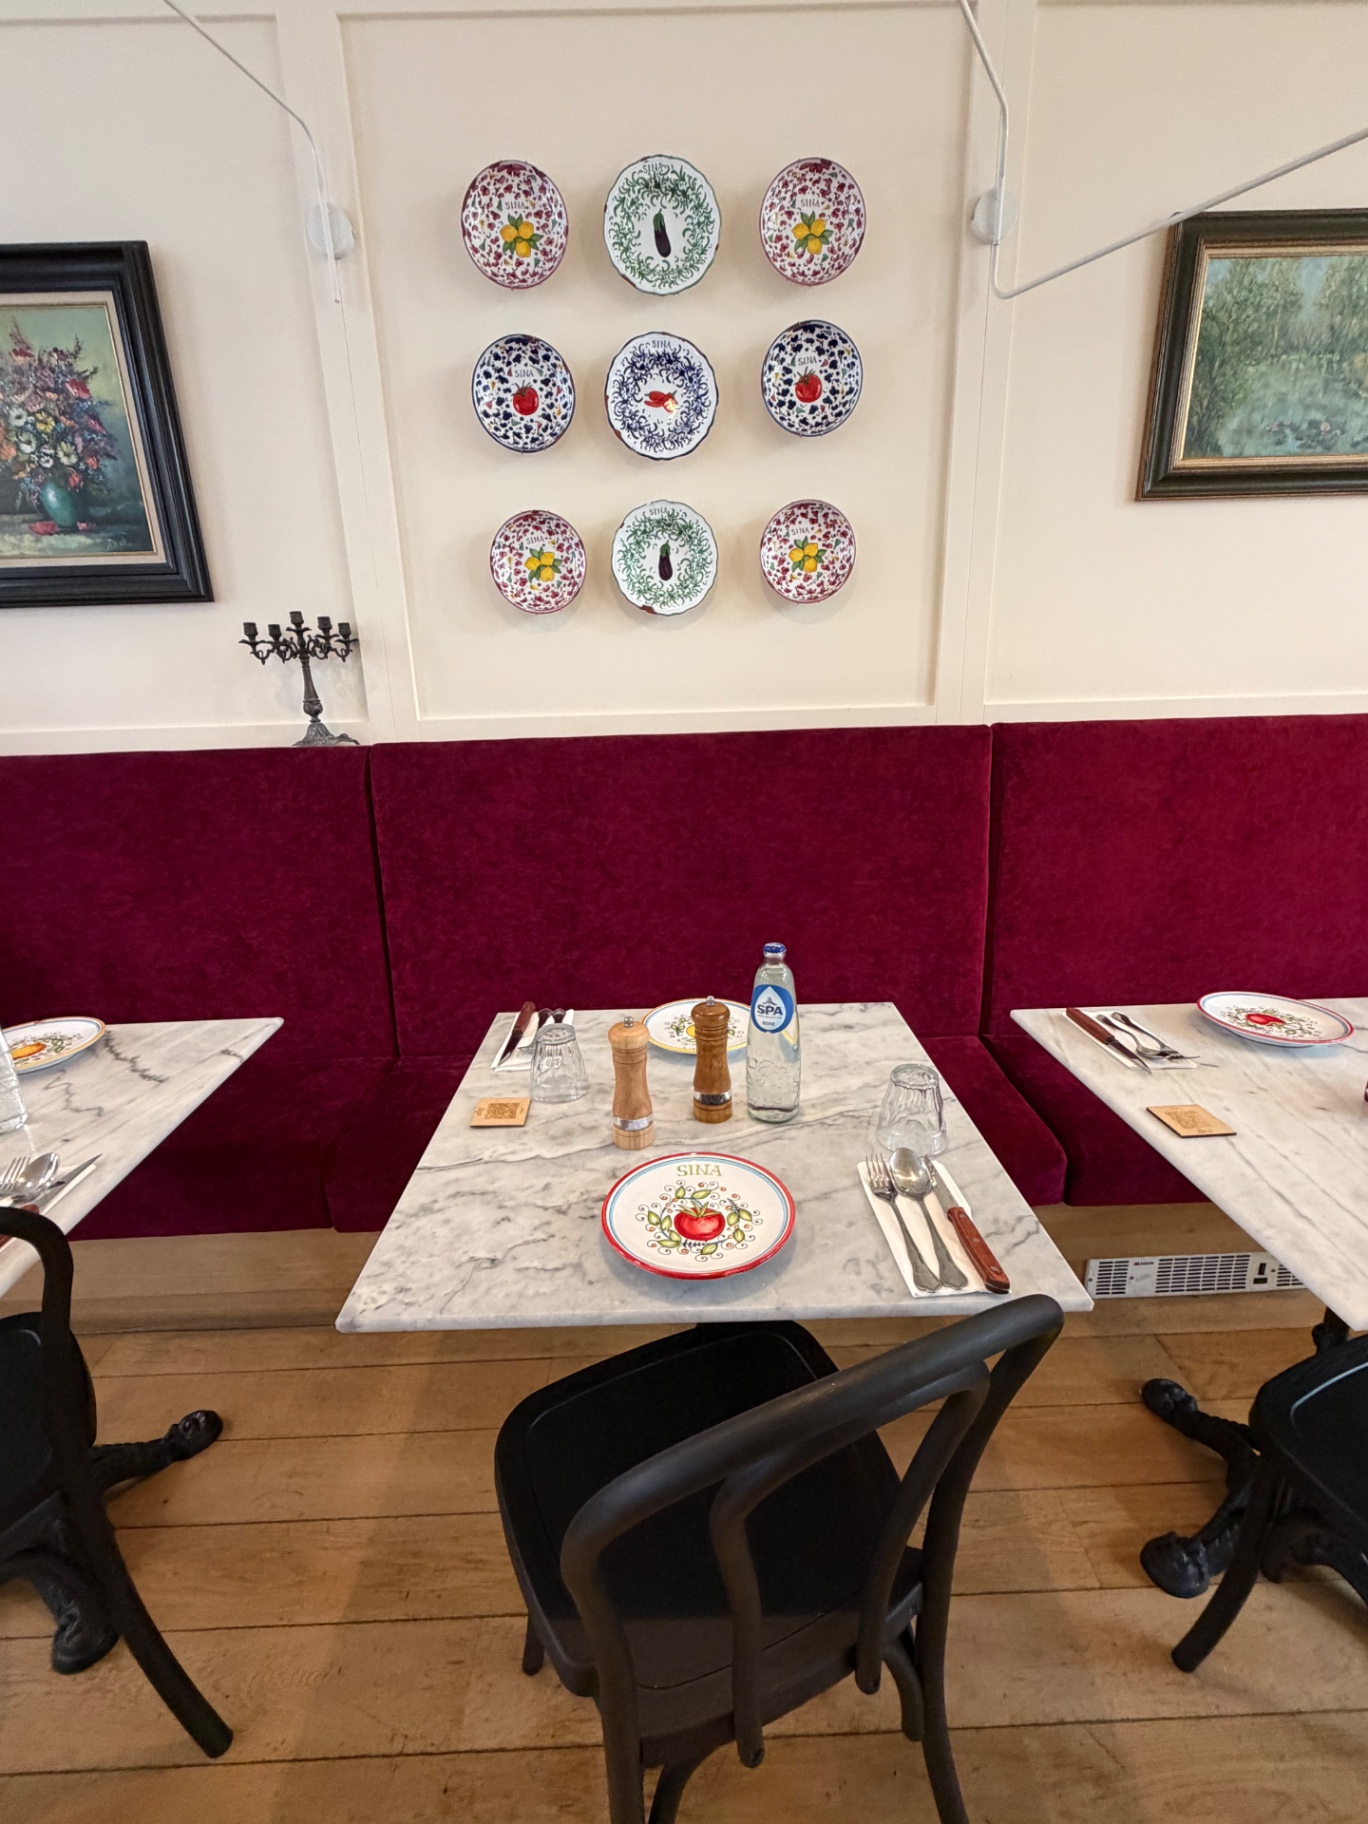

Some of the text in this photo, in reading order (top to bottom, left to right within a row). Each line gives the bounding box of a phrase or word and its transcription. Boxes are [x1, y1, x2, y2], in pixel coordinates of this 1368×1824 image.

[642, 162, 663, 173] SINA
[505, 200, 525, 210] SINA
[800, 198, 820, 208] SINA
[651, 339, 671, 349] SINA
[798, 356, 817, 366] SINA
[514, 369, 534, 378] SINA
[649, 506, 668, 516] SINA
[791, 526, 810, 536] SINA
[526, 534, 545, 545] SINA
[756, 1004, 784, 1016] SPA
[676, 1163, 723, 1177] SINA
